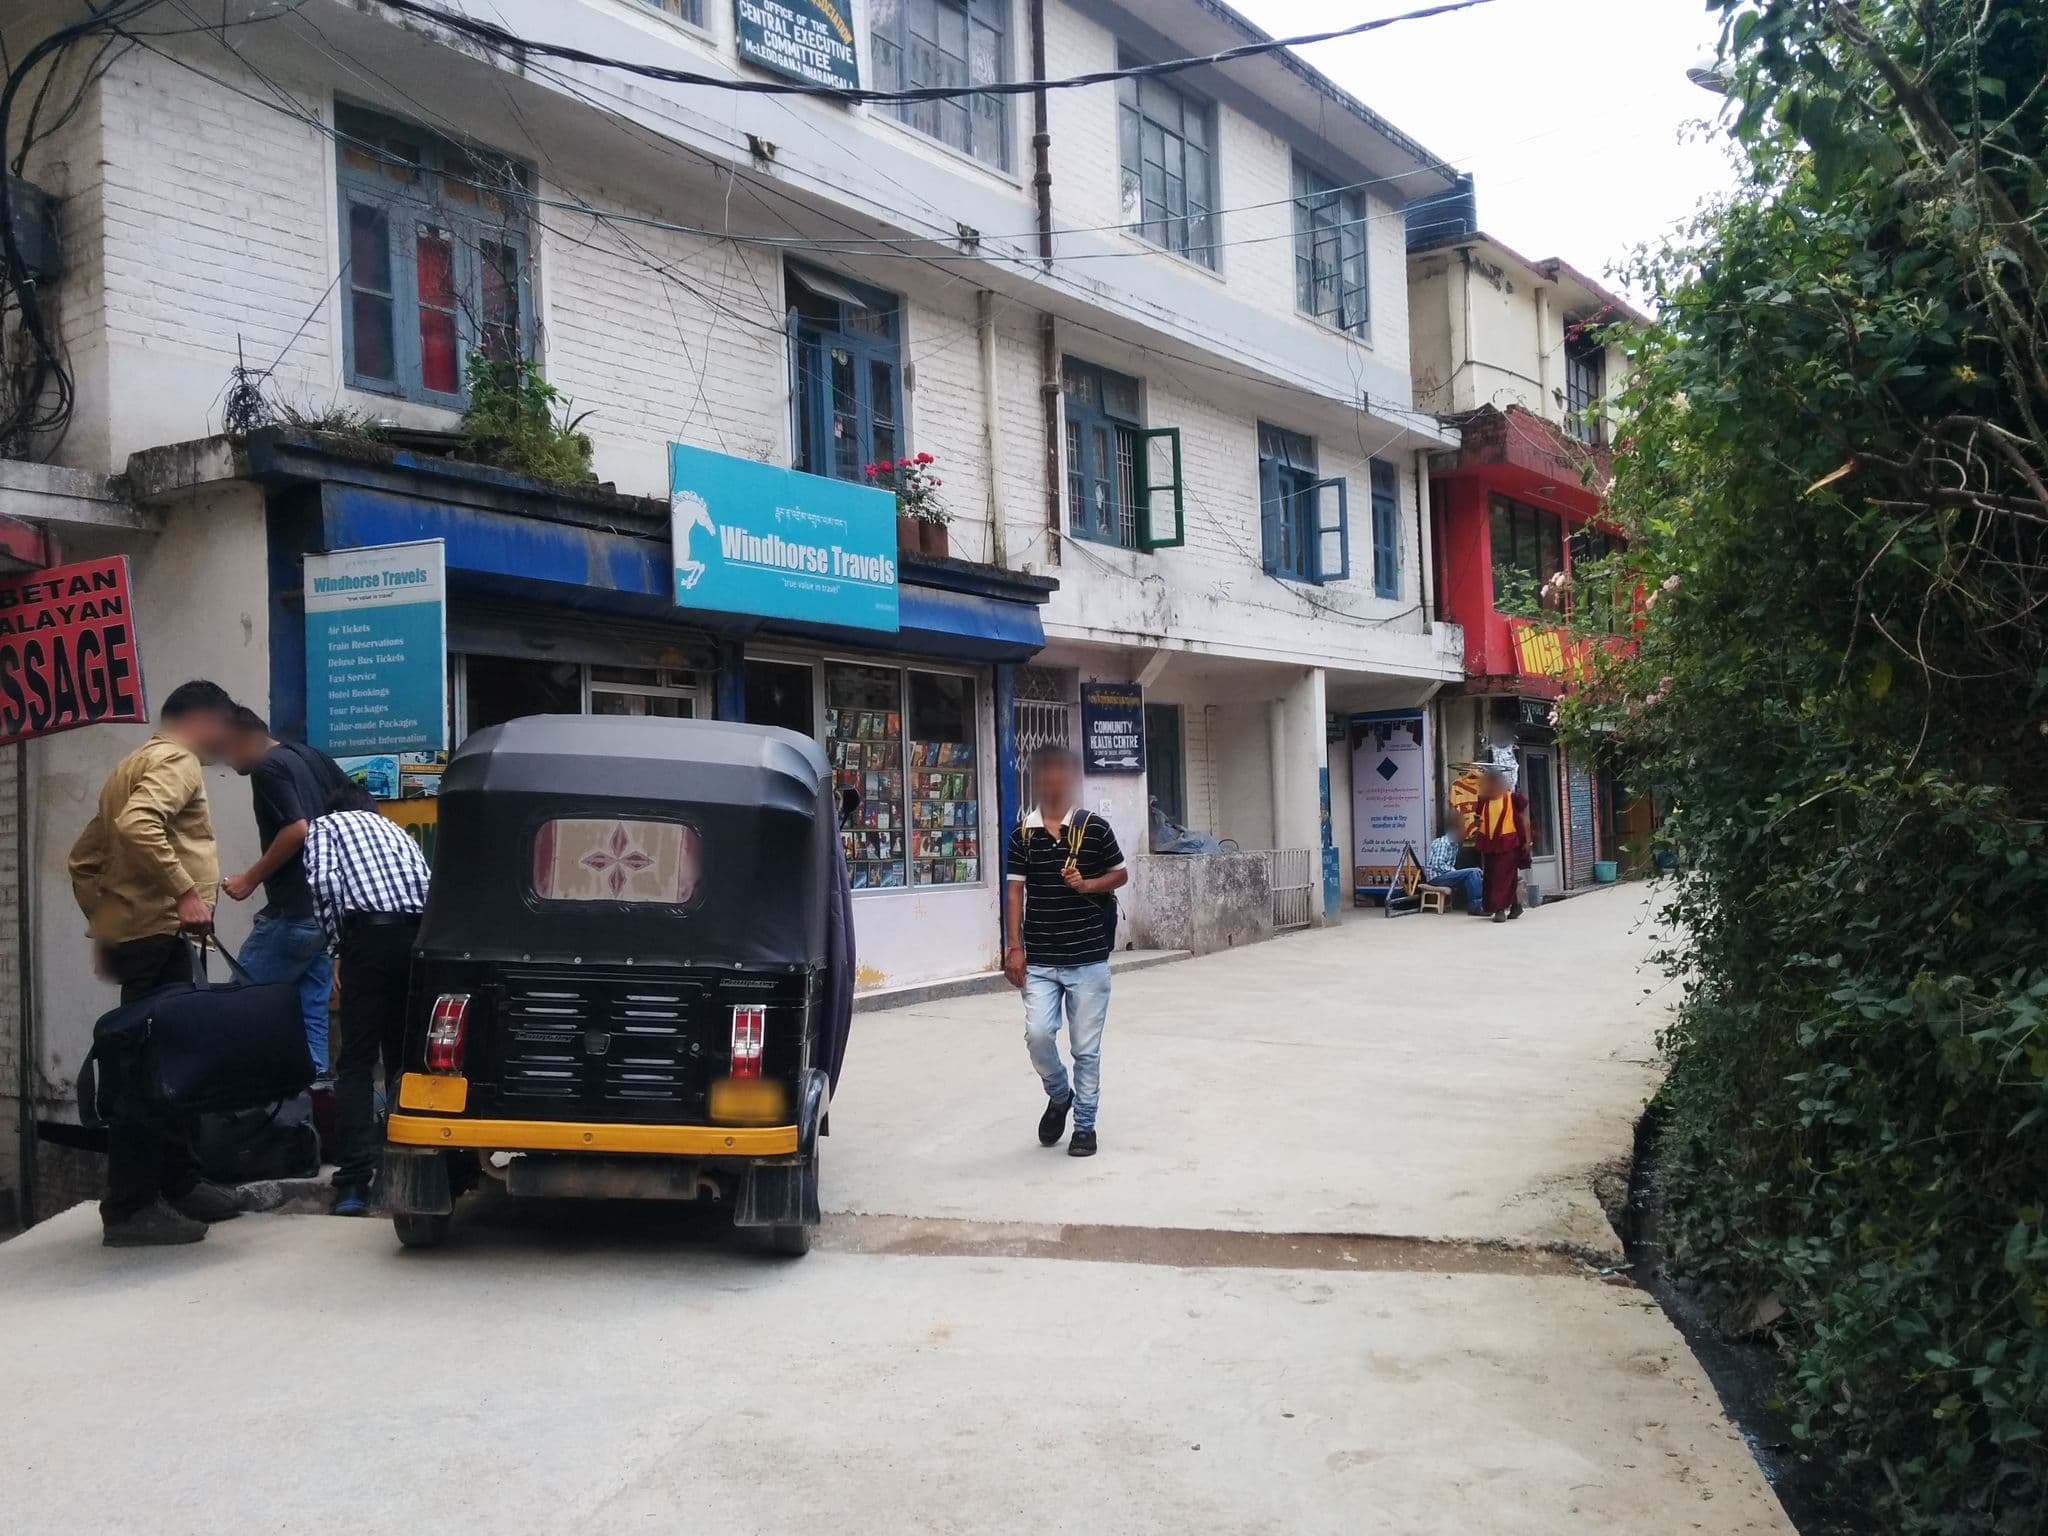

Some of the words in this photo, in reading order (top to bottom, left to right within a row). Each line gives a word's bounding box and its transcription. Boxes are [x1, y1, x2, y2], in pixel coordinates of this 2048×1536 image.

[763, 0, 795, 22] OFFICE
[796, 14, 807, 27] OF
[811, 19, 829, 35] THE
[739, 0, 792, 39] CENTRAL
[793, 25, 854, 64] EXECUTIVE
[763, 30, 832, 71] COMMITTEE
[719, 524, 829, 575] Windhorse
[831, 545, 895, 585] Travels
[313, 573, 380, 593] Windhorse
[382, 568, 428, 586] Travels
[0, 569, 117, 610] BETAN
[0, 596, 123, 636] ALAYAN
[328, 626, 339, 635] Air
[341, 624, 371, 634] Tickets
[327, 642, 350, 652] Train
[351, 638, 404, 650] Reservations
[328, 657, 356, 668] Deluxe
[357, 655, 374, 666] Bus
[376, 653, 406, 663] Tickets
[0, 624, 136, 736] SSAGE
[328, 673, 346, 684] Taxi
[347, 671, 377, 682] Service
[329, 689, 350, 700] Hotel
[352, 687, 390, 699] Bookings
[329, 706, 348, 716] Tour
[350, 703, 389, 715] Packages
[329, 721, 377, 732] Tailor-made
[379, 717, 418, 729] Packages
[1093, 721, 1133, 734] COMMUNITY
[329, 739, 347, 749] Free
[1090, 735, 1112, 749] HEALTH
[1113, 735, 1139, 748] CENTRE
